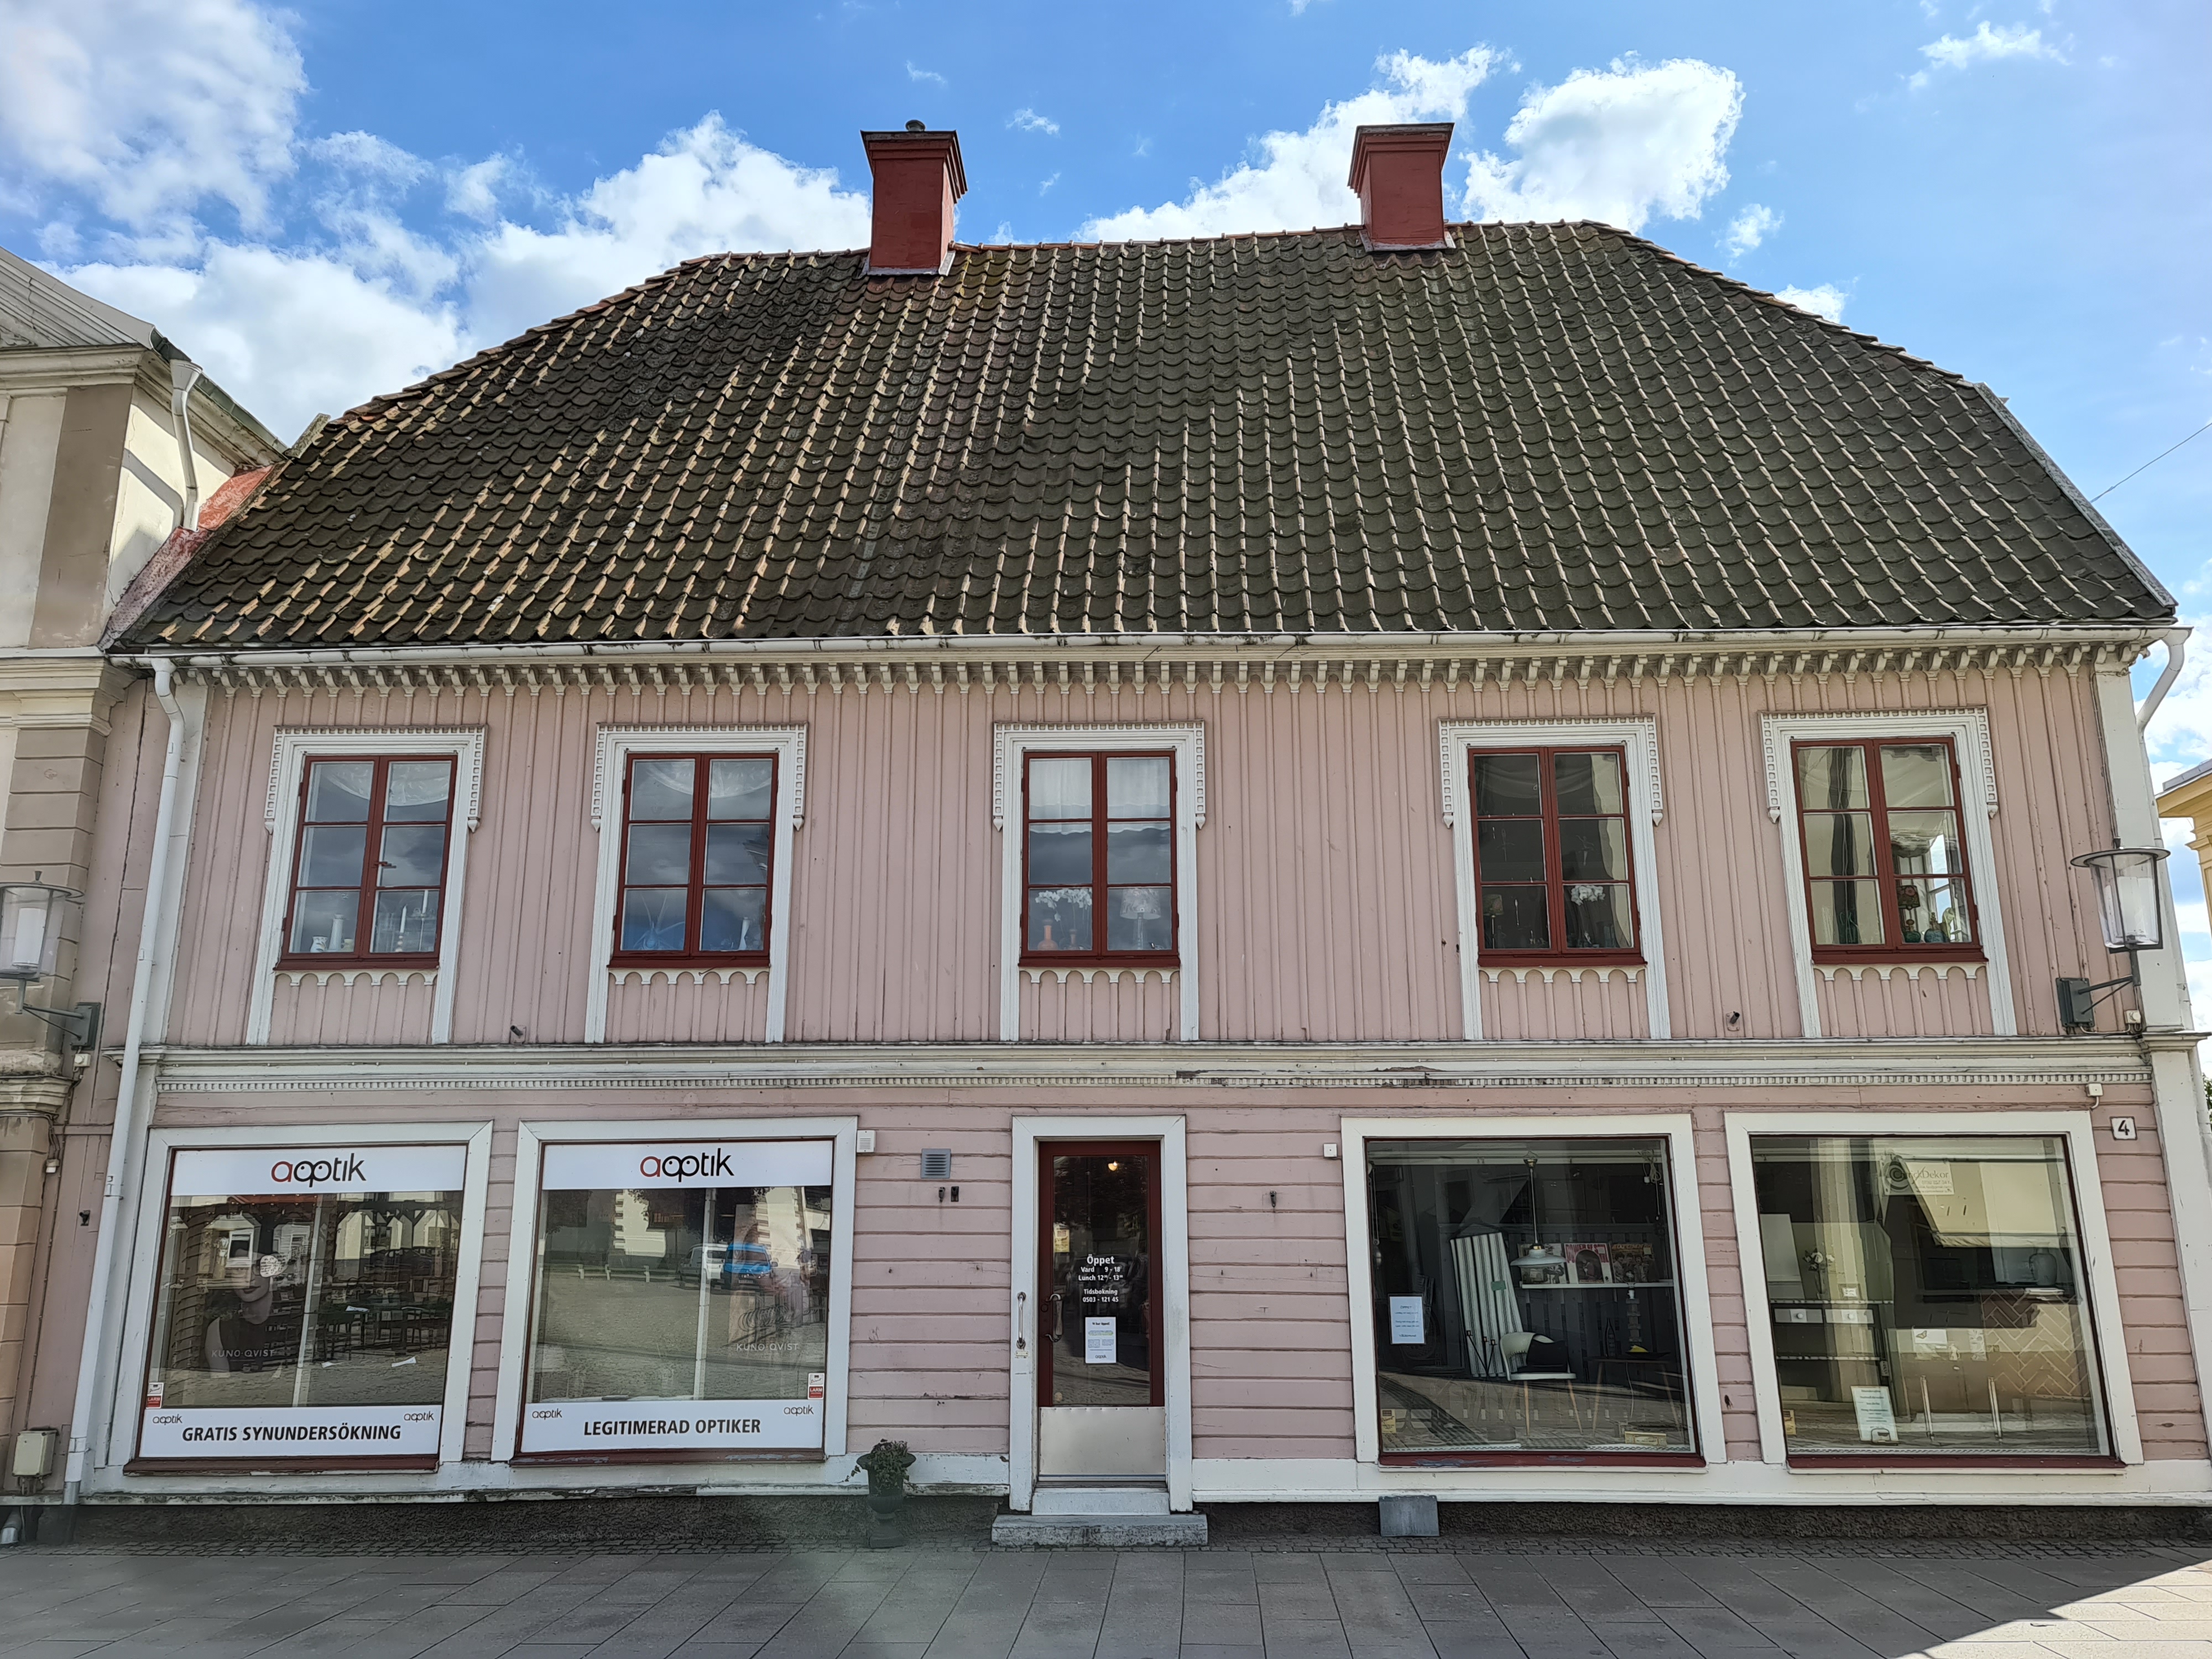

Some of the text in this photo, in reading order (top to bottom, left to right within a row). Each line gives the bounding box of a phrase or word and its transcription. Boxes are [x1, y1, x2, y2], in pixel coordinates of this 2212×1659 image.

[2118, 1120, 2130, 1136] 4
[1087, 1254, 1115, 1266] Öppet
[182, 1422, 401, 1442] GRATIS SYNUNDERSÖKNING
[584, 1419, 761, 1436] LEGITIMERAD OPTIKER
